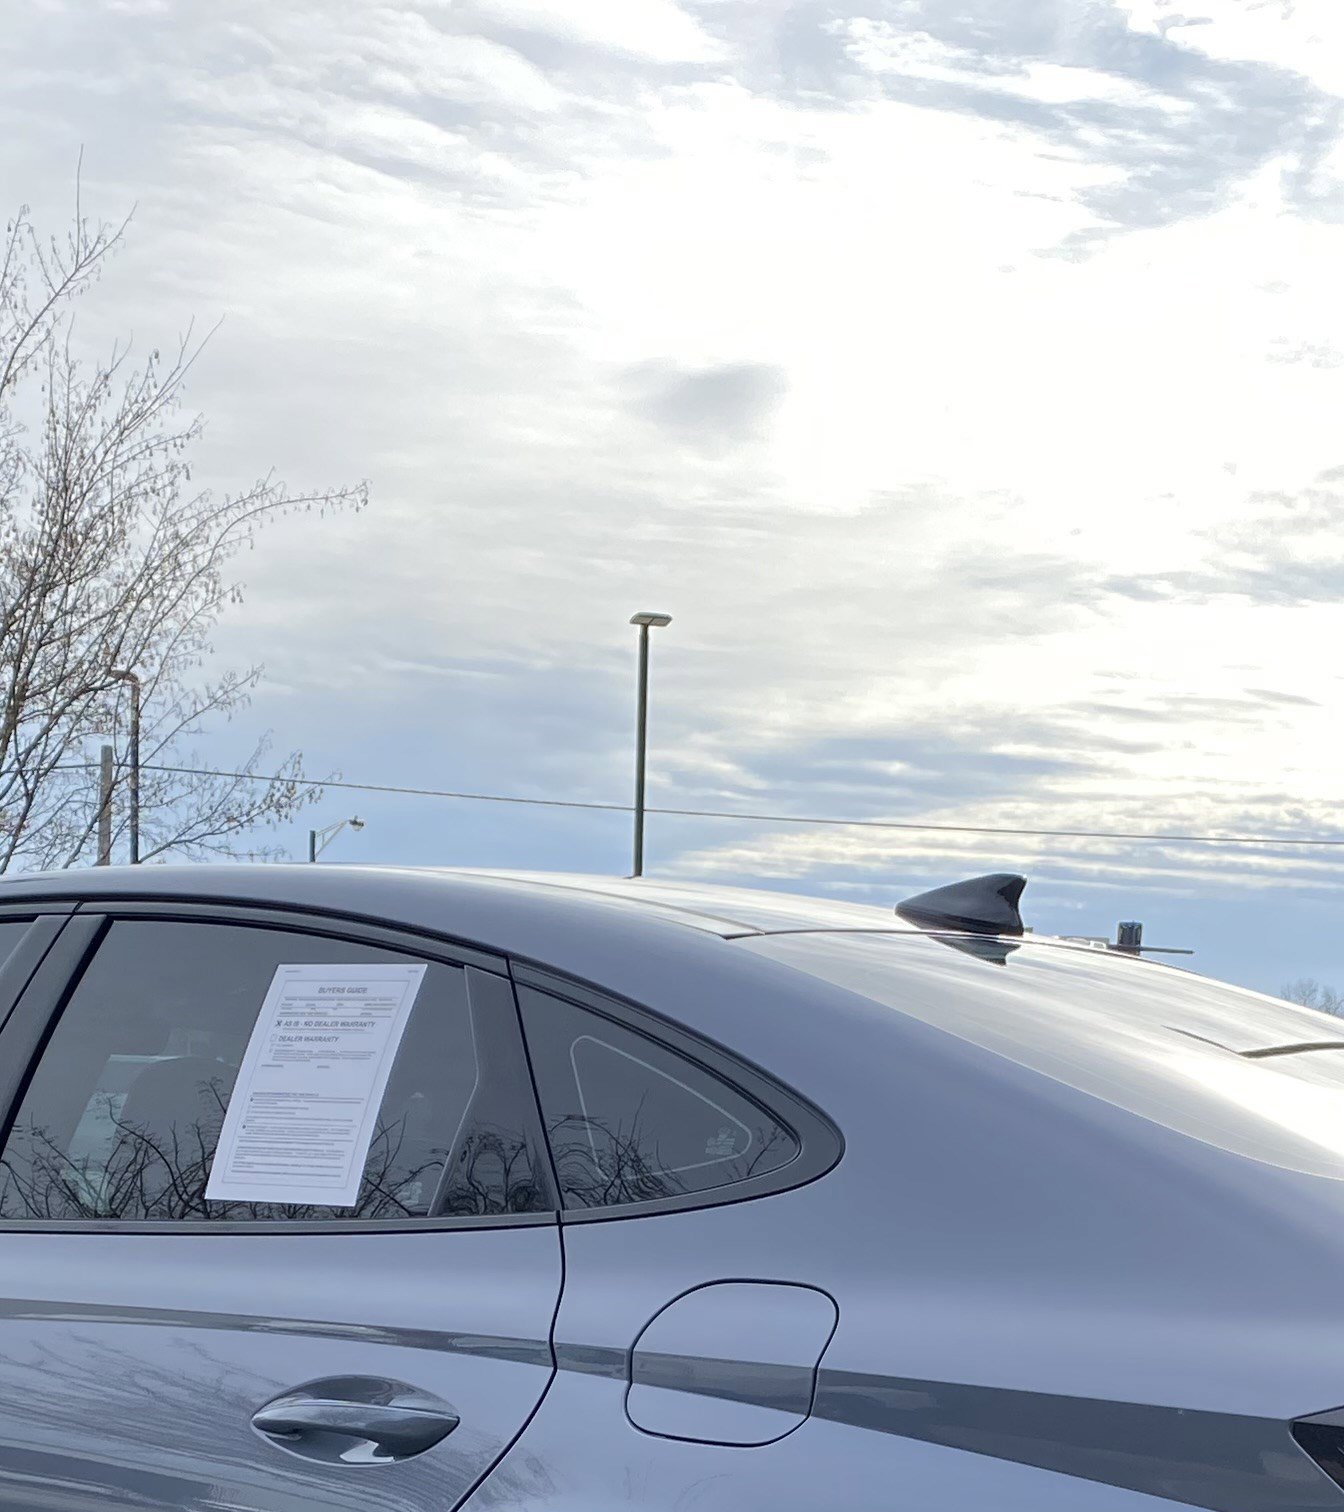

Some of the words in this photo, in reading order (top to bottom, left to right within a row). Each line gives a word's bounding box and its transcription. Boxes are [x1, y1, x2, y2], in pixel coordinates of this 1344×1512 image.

[317, 986, 346, 994] BUYERS
[346, 986, 368, 994] GUIDE
[314, 1020, 339, 1028] DEALER
[339, 1020, 376, 1028] WARRANTY
[303, 1035, 339, 1043] WARRANTY
